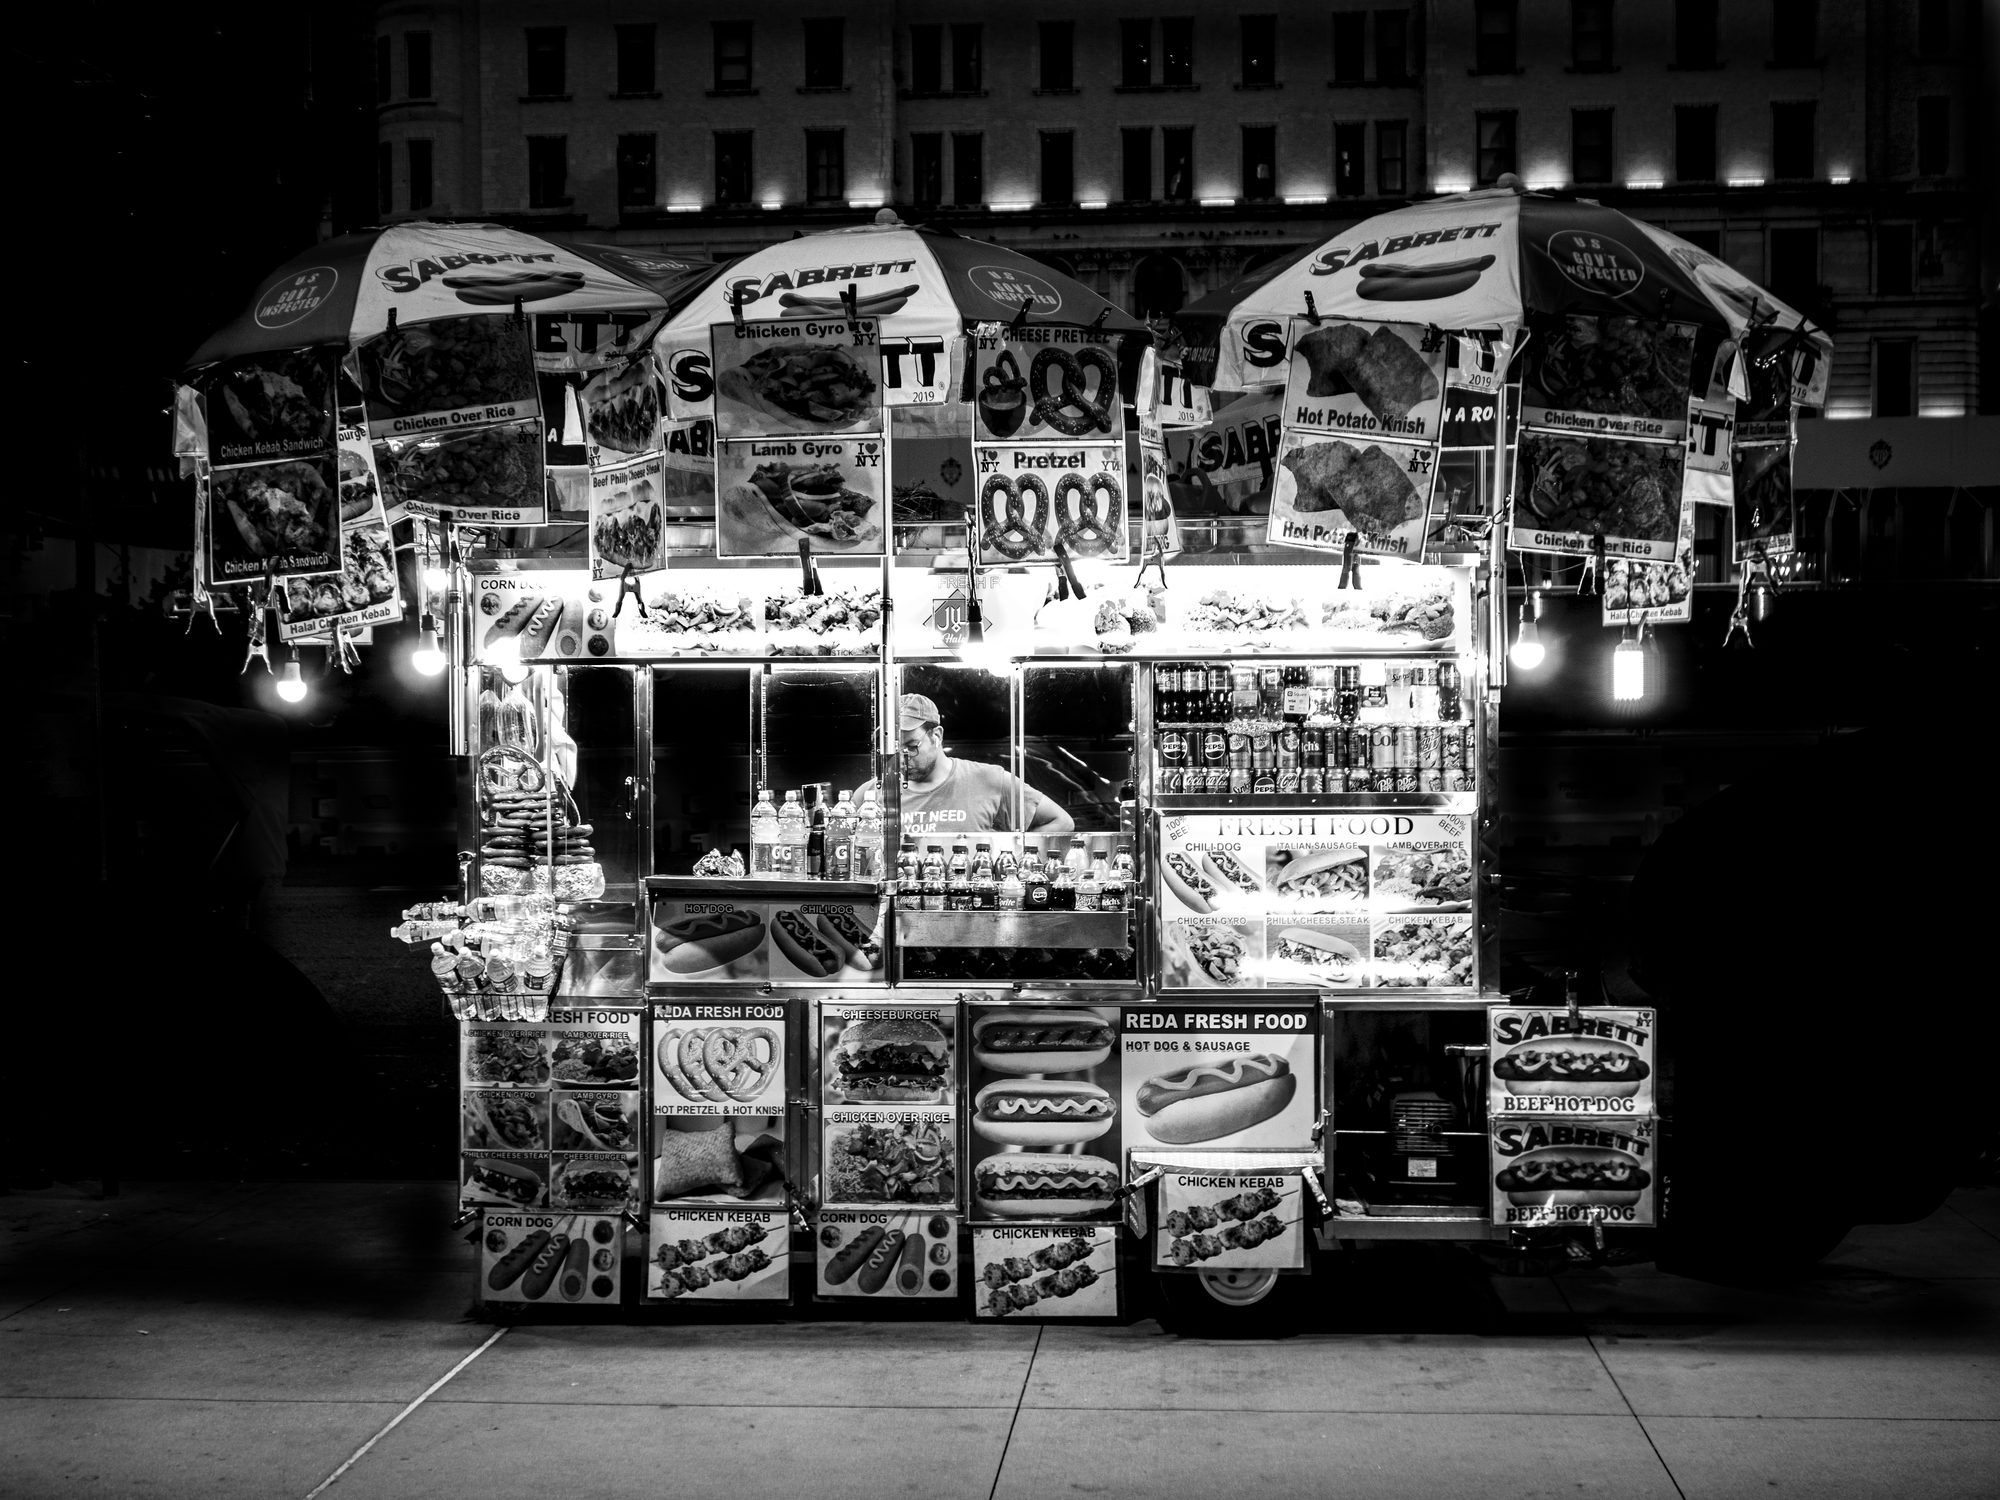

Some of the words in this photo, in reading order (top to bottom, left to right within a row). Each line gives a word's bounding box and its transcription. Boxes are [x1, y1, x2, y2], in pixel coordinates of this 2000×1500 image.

[1309, 224, 1502, 276] SABRETT
[376, 250, 556, 292] SABRETT
[724, 258, 916, 305] SABRETT
[259, 296, 320, 319] INSPECTED
[735, 324, 800, 340] Chicken
[805, 322, 845, 340] Gyro
[1002, 328, 1050, 343] CHEESE
[853, 332, 876, 347] NY
[979, 337, 998, 350] NY
[1469, 373, 1492, 388] 2019
[912, 391, 935, 403] 2019
[393, 414, 448, 432] Chicken
[451, 410, 482, 425] Over
[486, 406, 516, 419] Rice
[1296, 406, 1323, 425] Hot
[1327, 408, 1377, 430] Potato
[1381, 415, 1425, 435] Knish
[1544, 410, 1595, 430] Chicken
[1599, 416, 1630, 433] Over
[1633, 419, 1663, 435] Rice
[517, 434, 539, 444] NY
[221, 443, 253, 459] Chicken
[255, 440, 281, 454] Kebab
[283, 437, 324, 452] Sandwich
[751, 442, 797, 457] Lamb
[802, 442, 843, 459] Gyro
[589, 456, 601, 466] NY
[855, 454, 880, 467] NY
[981, 461, 1000, 473] NY
[1013, 451, 1086, 470] Pretzel
[1408, 460, 1432, 474] NY
[592, 473, 608, 489] Beef
[610, 469, 628, 486] Philly
[629, 466, 645, 482] Cheese
[457, 509, 488, 520] Over
[492, 509, 520, 521] Rice
[1282, 520, 1309, 539] Hot
[1366, 531, 1408, 554] Knish
[1534, 532, 1584, 550] Chicken
[1589, 537, 1619, 553] Oer
[1622, 539, 1652, 555] Rice
[224, 559, 260, 574] Chicken
[262, 557, 289, 572] Kab
[289, 553, 329, 569] Sandwich
[481, 579, 516, 590] CORN
[1661, 607, 1683, 619] Kebab
[289, 619, 316, 635] Halal
[361, 606, 391, 624] Kebab
[929, 809, 967, 823] NEED
[904, 823, 936, 833] YOUR
[1217, 816, 1317, 836] FRESH
[1330, 816, 1414, 836] FOOD
[1437, 818, 1462, 838] BEEF
[1185, 842, 1212, 852] CHILI
[1217, 842, 1241, 852] DOG
[1276, 841, 1311, 850] ITALIAN
[1315, 841, 1358, 850] SAUSAGE
[1386, 841, 1412, 850] LAMB
[1414, 841, 1439, 850] OVER
[1442, 841, 1464, 850] RICE
[781, 846, 792, 861] G
[835, 845, 848, 860] G
[685, 903, 707, 914] HOT
[709, 903, 734, 914] DOG
[801, 904, 828, 914] CHILI
[830, 904, 854, 915] DOG
[1177, 916, 1217, 926] CHICKEN
[1221, 916, 1247, 926] GYRO
[1266, 916, 1296, 925] PHILLY
[1300, 916, 1334, 925] CHEESE
[1337, 916, 1369, 925] STEAK
[1388, 916, 1429, 925] CHICKEN
[1432, 916, 1464, 925] KEBAB
[546, 1011, 583, 1024] RESH
[587, 1011, 630, 1024] FOOD
[696, 1006, 742, 1018] FRESH
[746, 1006, 784, 1018] FOOD
[842, 1009, 938, 1021] CHEESEBURGER
[1126, 1013, 1179, 1030] REDA
[1184, 1013, 1248, 1030] FRESH
[1254, 1014, 1308, 1030] FOOD
[468, 1030, 502, 1038] CHICKEN
[504, 1030, 525, 1038] OVER
[563, 1031, 585, 1039] LAMB
[587, 1031, 607, 1039] OVER
[610, 1031, 629, 1039] RICE
[1493, 1011, 1649, 1046] SABRETT
[1125, 1040, 1150, 1052] HOT
[1154, 1040, 1179, 1052] DOG
[1182, 1041, 1191, 1051] &
[1194, 1041, 1250, 1052] SAUSAGE
[477, 1091, 511, 1099] CHICKEN
[514, 1091, 536, 1099] GYRO
[572, 1092, 594, 1100] LAMB
[596, 1092, 619, 1100] GYRO
[655, 1105, 674, 1116] HOT
[677, 1105, 718, 1116] PRETZEL
[723, 1105, 730, 1115] &
[733, 1105, 753, 1116] HOT
[755, 1105, 784, 1116] KNISH
[1503, 1096, 1550, 1112] BEEF
[1554, 1096, 1591, 1112] HOT
[1595, 1097, 1636, 1112] DOG
[832, 1111, 884, 1123] CHICKEN
[886, 1111, 919, 1123] OVER
[922, 1112, 949, 1123] RICE
[1494, 1122, 1650, 1157] SABRETT
[563, 1153, 627, 1161] CHEESEBURGER
[1179, 1175, 1235, 1188] CHICKEN
[1239, 1176, 1284, 1188] KEBAB
[668, 1210, 725, 1222] CHICKEN
[728, 1211, 771, 1223] KEBAB
[820, 1212, 856, 1224] CORN
[859, 1213, 887, 1224] DOG
[1505, 1206, 1550, 1222] BEEF
[1597, 1206, 1636, 1221] DOG
[486, 1216, 523, 1227] CORN
[526, 1217, 553, 1228] DOG
[992, 1227, 1050, 1240] CHICKEN
[1053, 1227, 1096, 1239] KEBAB
